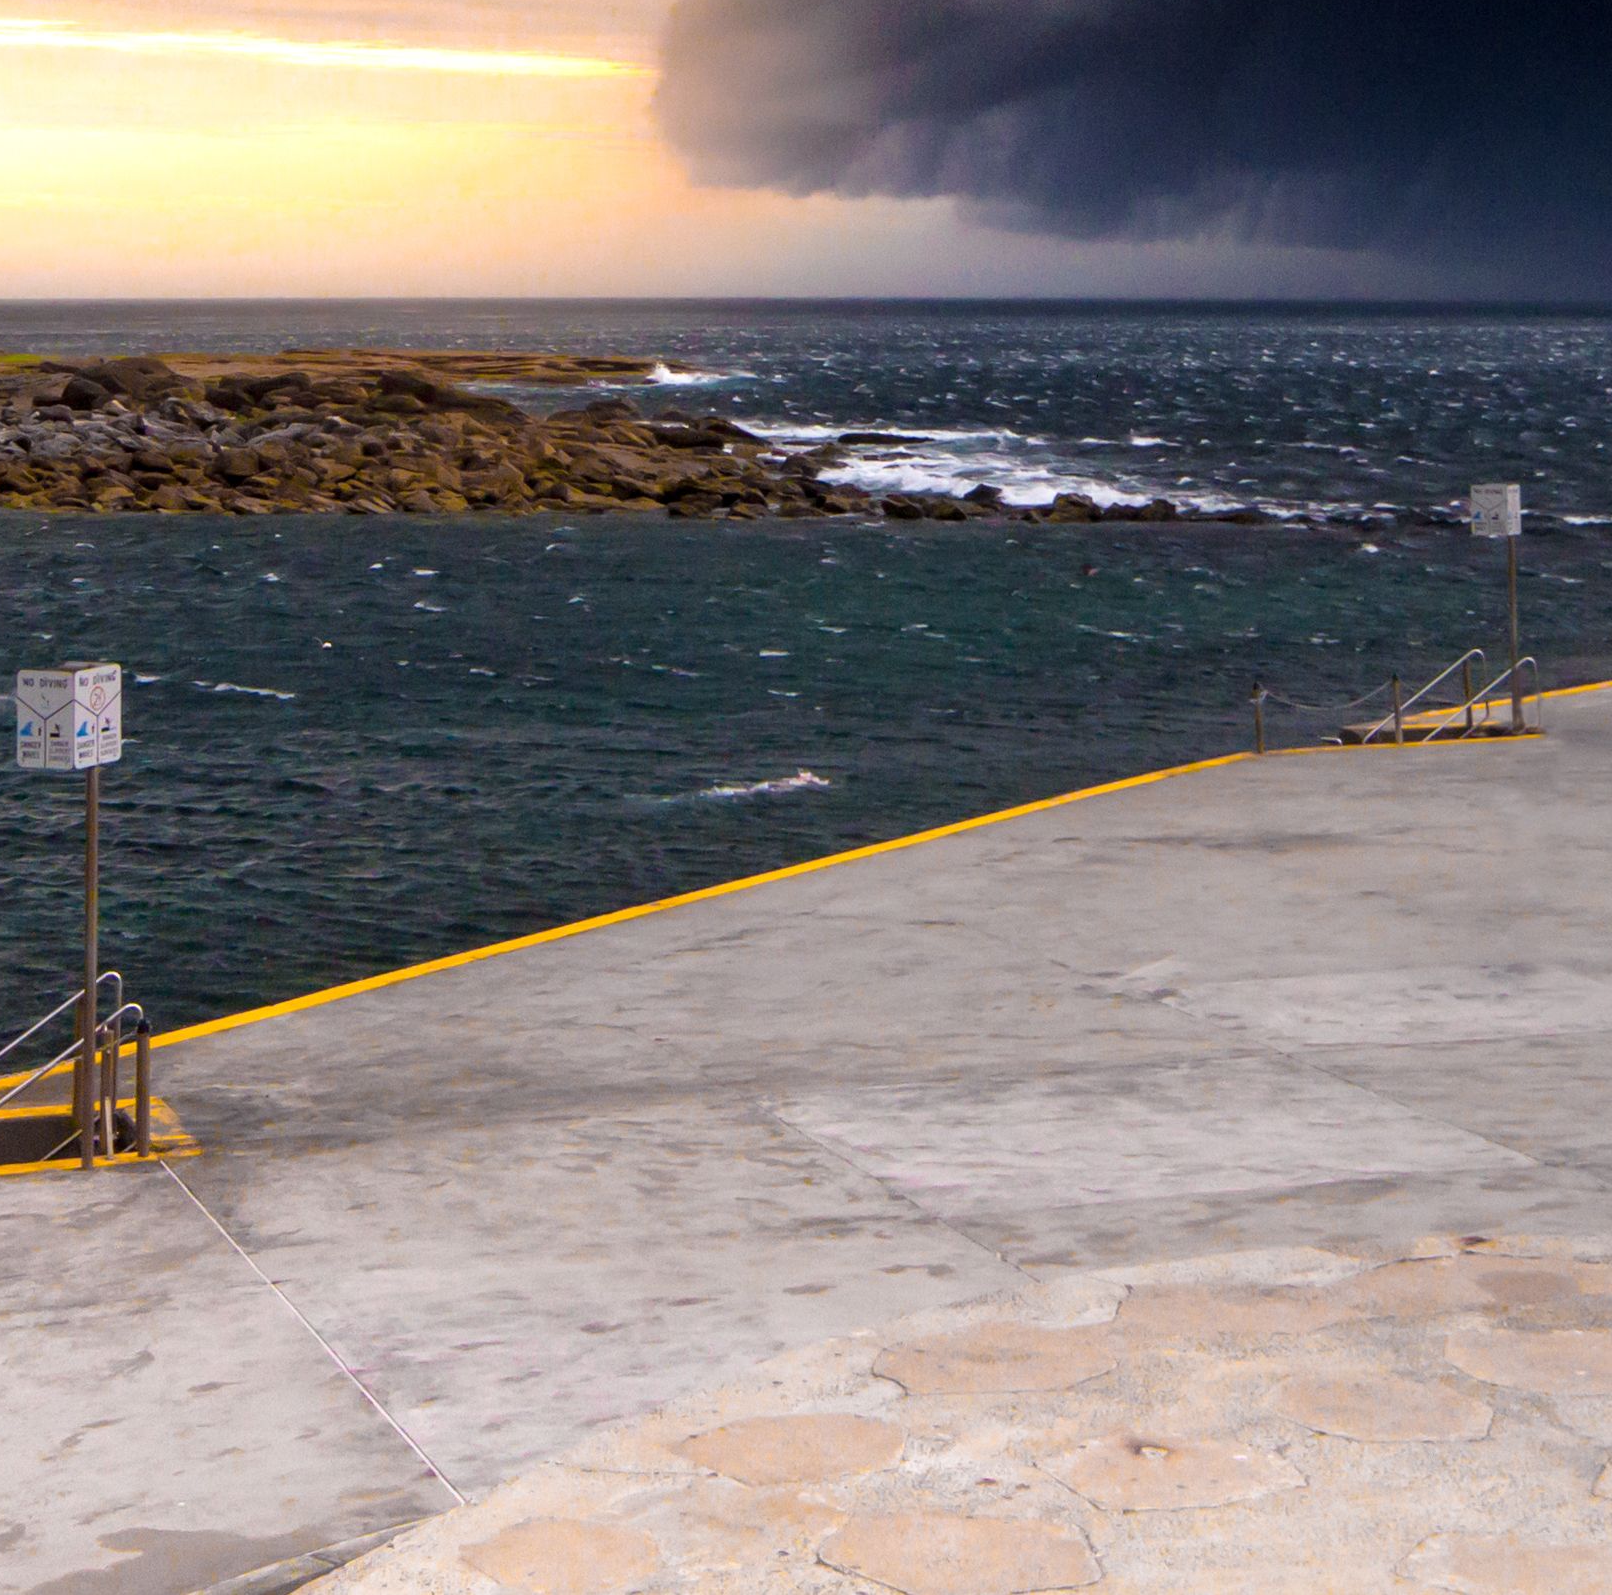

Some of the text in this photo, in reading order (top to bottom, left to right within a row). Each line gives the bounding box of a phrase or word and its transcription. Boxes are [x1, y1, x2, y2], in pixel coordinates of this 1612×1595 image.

[22, 677, 68, 689] NO DIVING
[79, 670, 117, 687] NO DIVING
